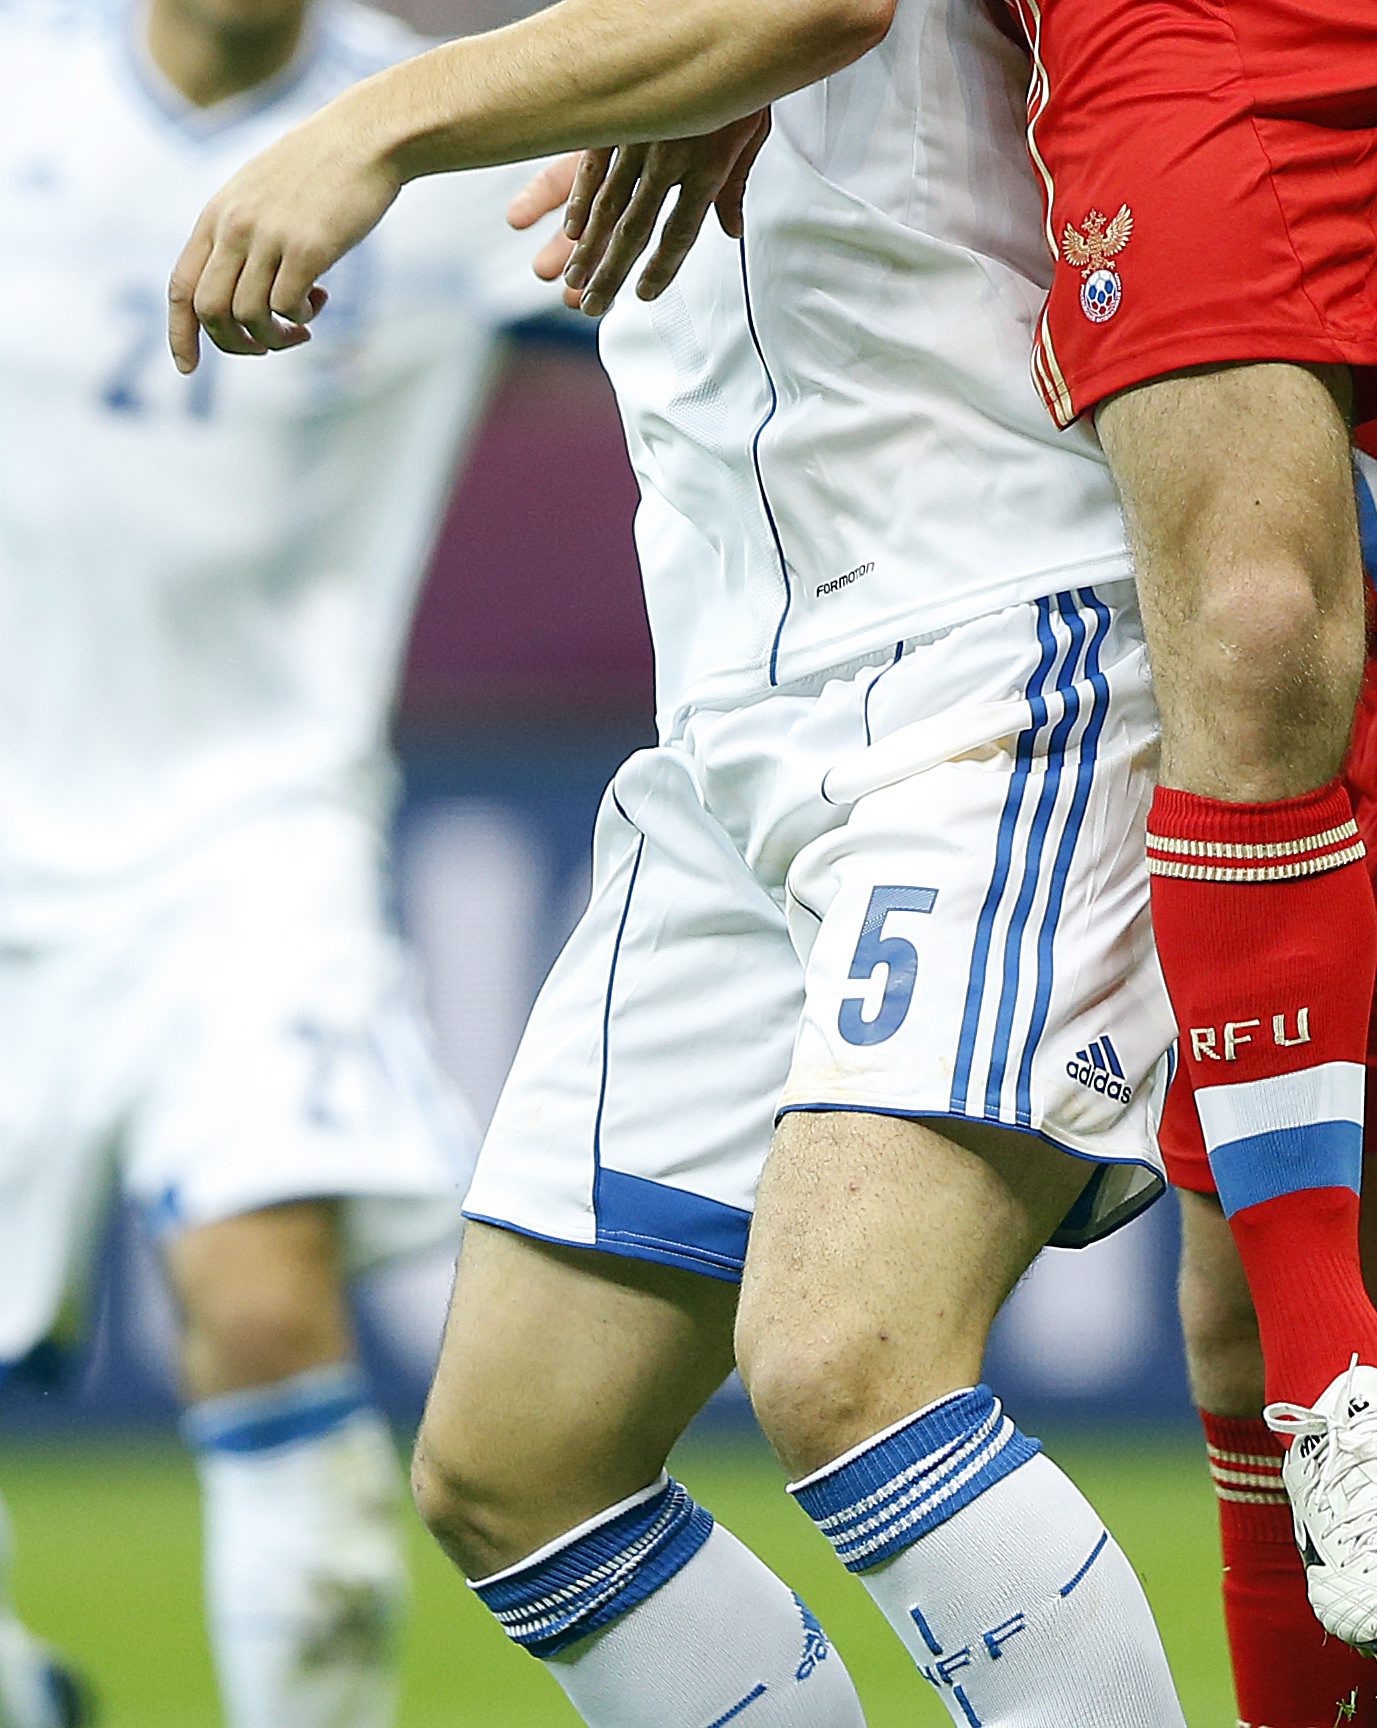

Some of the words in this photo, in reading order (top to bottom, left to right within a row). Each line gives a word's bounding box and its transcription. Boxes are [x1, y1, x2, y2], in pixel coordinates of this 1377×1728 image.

[815, 561, 876, 599] FORMOTON
[838, 884, 940, 1047] 5
[1065, 1056, 1133, 1106] adidas
